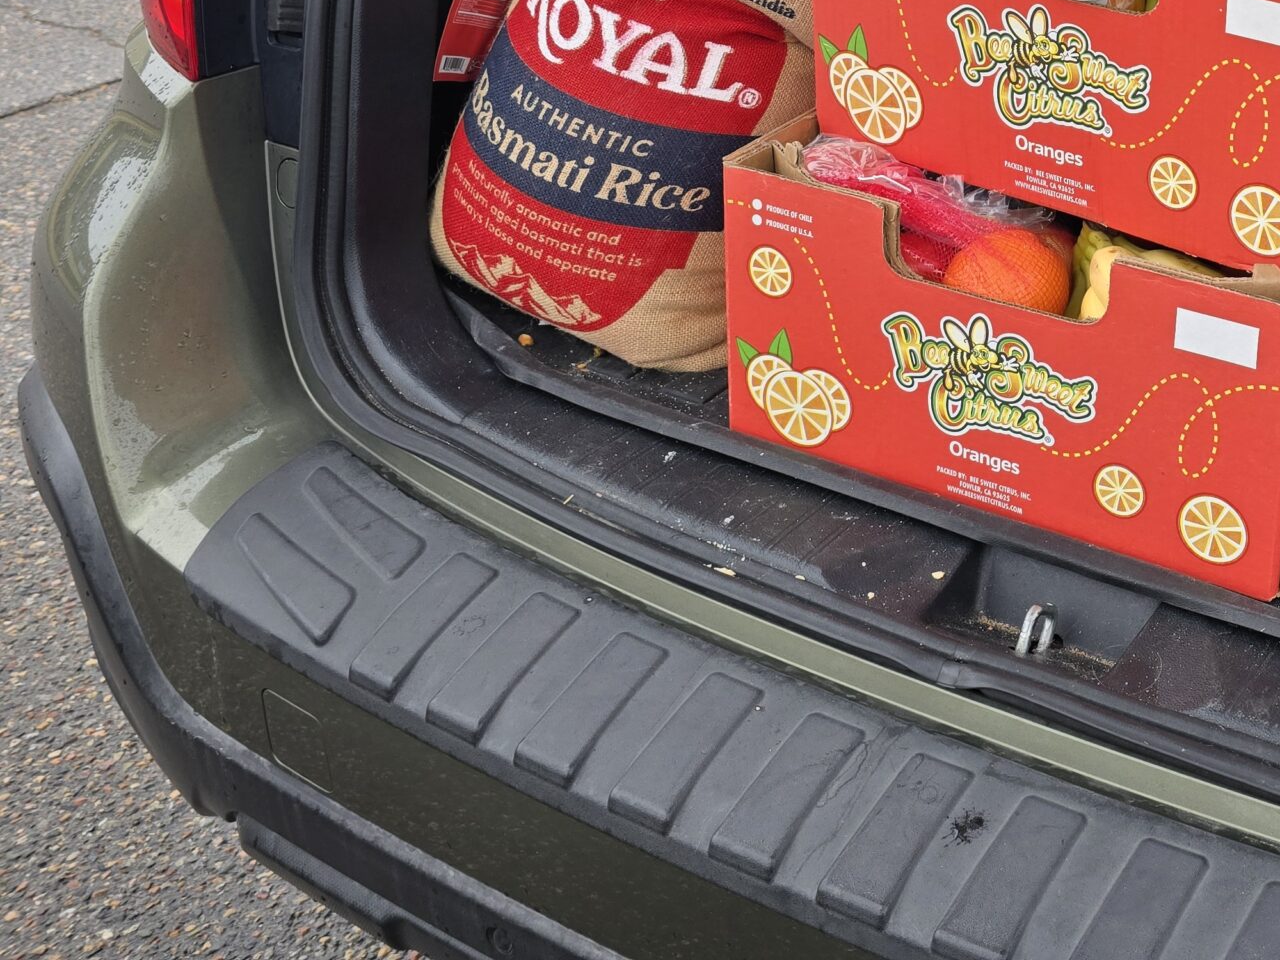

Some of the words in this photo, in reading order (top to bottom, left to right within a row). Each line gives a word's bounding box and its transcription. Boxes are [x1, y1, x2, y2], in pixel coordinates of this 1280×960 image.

[950, 7, 1013, 82] Bee
[1049, 26, 1148, 109] Sweet
[472, 68, 595, 193] Basmati
[594, 163, 711, 212] Rice
[510, 84, 655, 157] AUTHENTIC
[1004, 160, 1024, 171] PACKED
[1035, 169, 1045, 178] BEE
[1045, 172, 1062, 182] SWEET
[1015, 134, 1083, 166] Oranges
[468, 159, 515, 208] Naturally
[516, 203, 583, 238] aromatic
[586, 230, 622, 246] and
[1049, 181, 1057, 189] CA
[452, 162, 488, 208] premium
[490, 205, 519, 231] aged
[520, 221, 583, 256] basmati
[587, 246, 624, 265] that
[627, 252, 642, 267] is
[453, 188, 483, 223] always
[484, 217, 514, 246] loose
[516, 242, 543, 260] and
[546, 254, 617, 282] separate
[765, 219, 790, 232] PRODUCE
[798, 228, 814, 238] U.S.A.
[766, 204, 790, 217] PRODUCE
[790, 211, 798, 219] OF
[798, 213, 813, 223] CHILE
[884, 314, 951, 387] Bee
[985, 336, 1094, 419] Sweet
[936, 465, 957, 477] PACKED
[969, 475, 979, 484] BEE
[980, 479, 997, 490] SWEET
[949, 440, 1020, 475] Oranges
